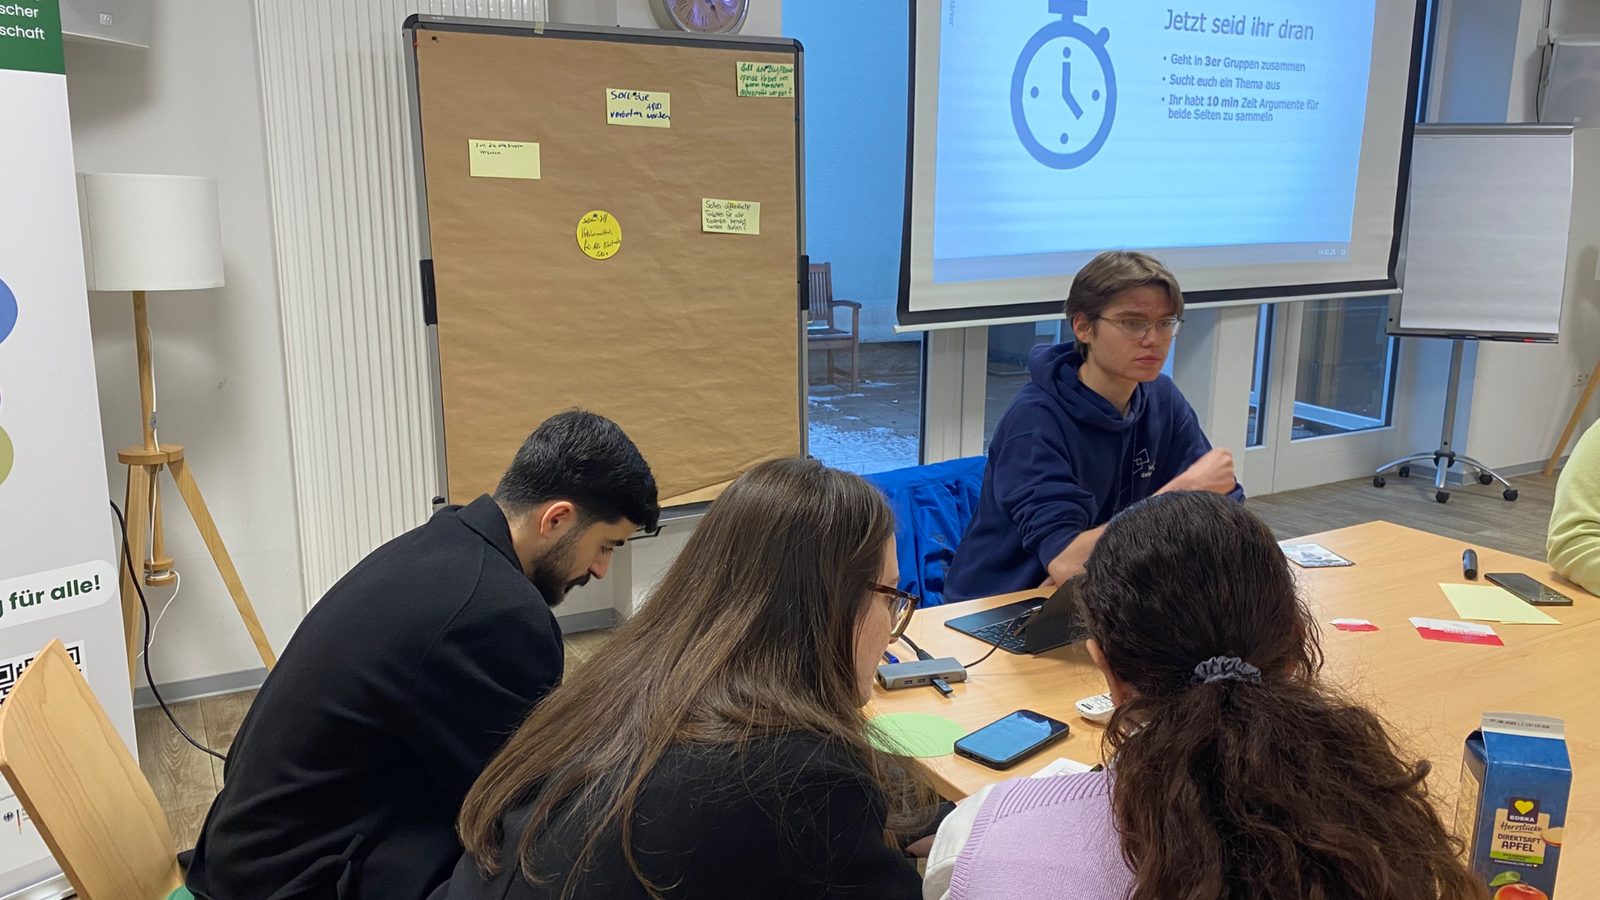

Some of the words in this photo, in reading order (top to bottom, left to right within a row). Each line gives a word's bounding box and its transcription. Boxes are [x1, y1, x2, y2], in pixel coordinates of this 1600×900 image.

[1164, 9, 1207, 32] Jetzt
[1211, 15, 1246, 35] seid
[1251, 16, 1274, 38] ihr
[1278, 19, 1314, 41] dran
[1170, 53, 1192, 66] Geht
[1194, 55, 1202, 66] in
[1205, 56, 1221, 67] 3er
[1223, 57, 1259, 71] Gruppen
[1261, 61, 1306, 72] zusammen
[1169, 74, 1194, 86] Sucht
[1197, 76, 1217, 88] euch
[1220, 77, 1232, 88] ein
[1235, 77, 1263, 90] Thema
[1266, 80, 1280, 91] aus
[1169, 94, 1183, 105] Ihr
[1184, 95, 1204, 107] habt
[1207, 96, 1219, 107] 10
[1221, 97, 1239, 108] min
[1241, 97, 1257, 109] Zeit
[1259, 98, 1304, 111] Argumente
[1306, 99, 1319, 110] für
[1168, 107, 1192, 119] beide
[1193, 109, 1221, 121] Seiten
[1223, 112, 1233, 121] zu
[1235, 111, 1273, 122] sammeln
[9, 589, 44, 610] für
[51, 574, 100, 600] alle!
[1500, 821, 1543, 832] Herzstücke
[1498, 833, 1541, 844] DIREKTSAFT
[1501, 840, 1535, 852] APFEL
